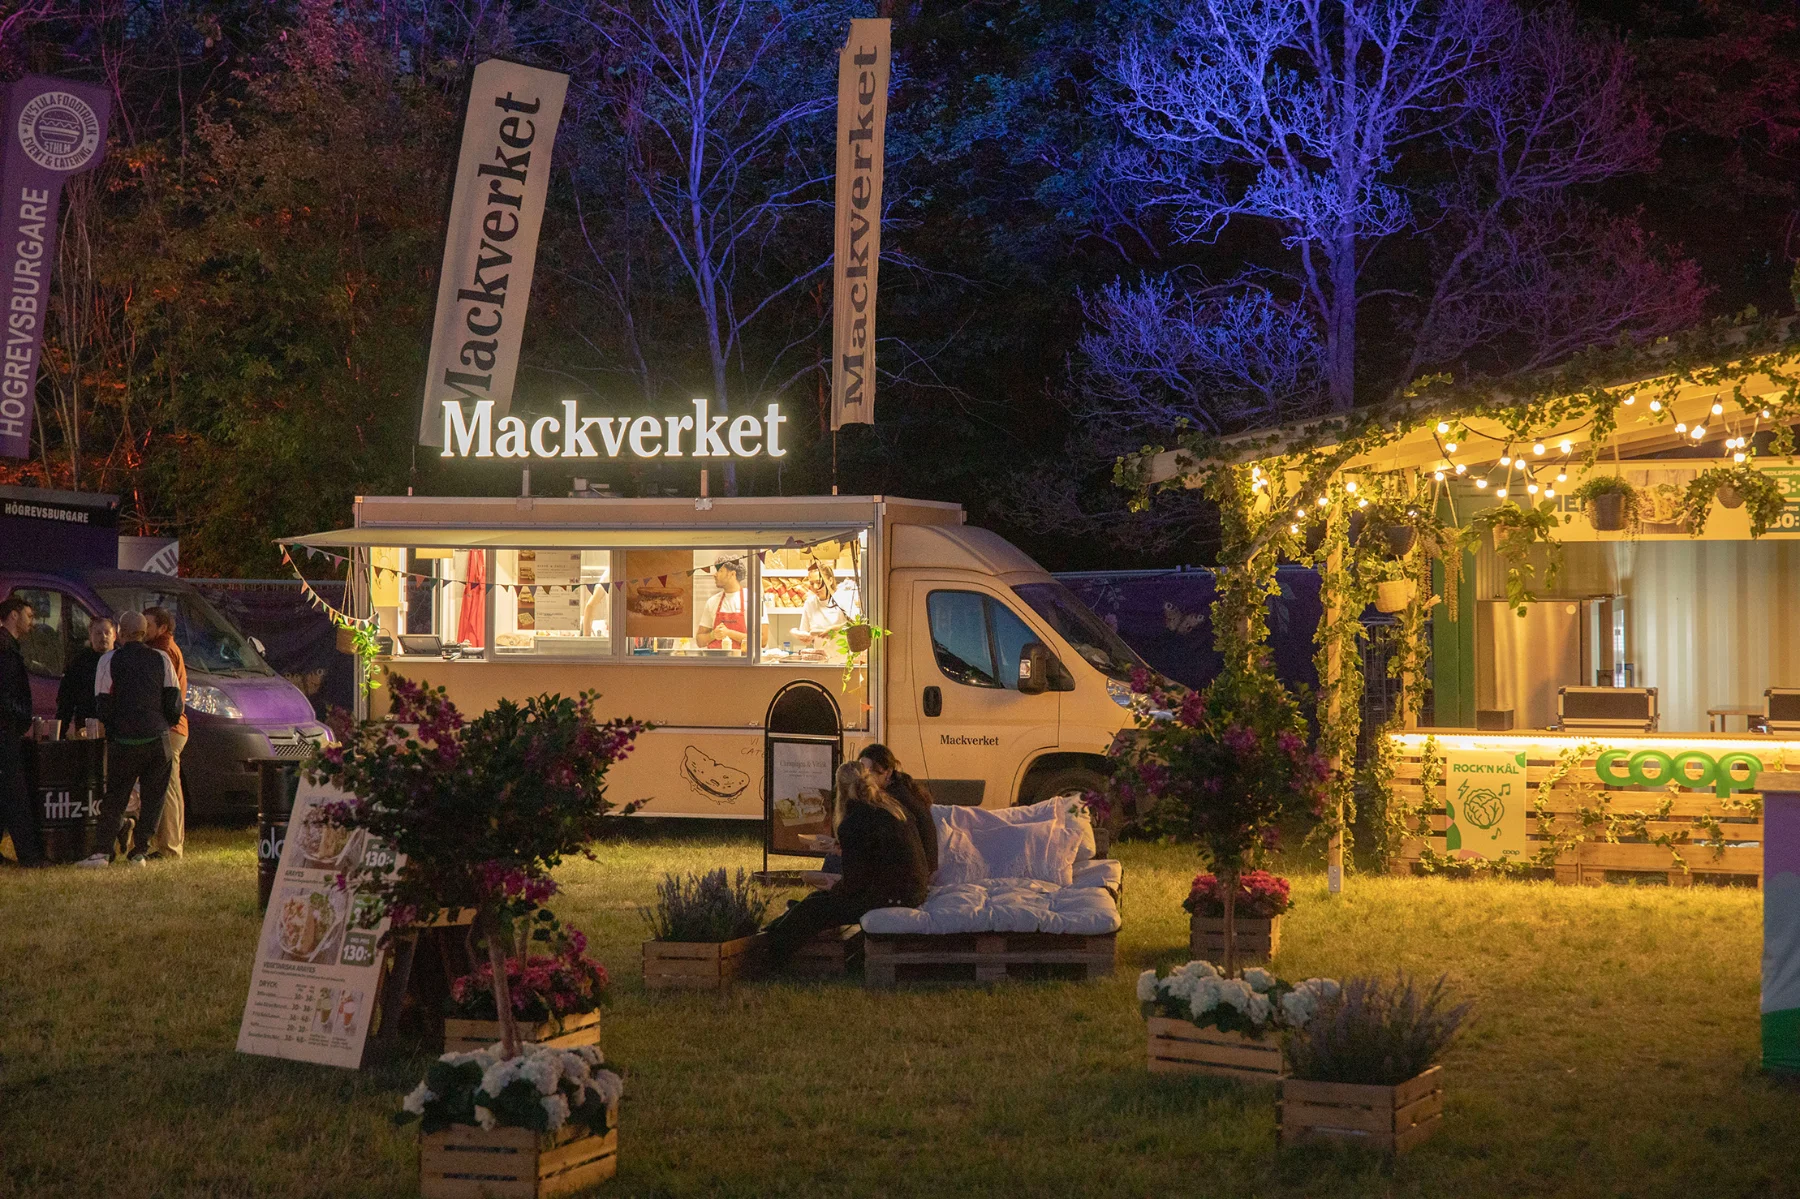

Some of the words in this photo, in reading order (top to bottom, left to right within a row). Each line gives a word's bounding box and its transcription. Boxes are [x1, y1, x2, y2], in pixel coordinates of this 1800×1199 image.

[57, 94, 98, 136] FOODTRUCK
[23, 136, 46, 162] EVENT
[45, 155, 52, 166] &
[54, 147, 92, 168] CATERING
[43, 141, 71, 153] STHLM
[842, 44, 878, 408] Mackverket
[440, 91, 541, 417] Mackverket
[440, 398, 787, 457] Mackverket
[5, 502, 89, 524] HÖGREVSBURGARE
[940, 734, 999, 746] Mackverket
[1453, 763, 1494, 773] ROCK'N
[1496, 762, 1520, 774] KÅL
[1595, 749, 1764, 799] coop
[365, 851, 394, 868] 130:-
[343, 944, 372, 961] 130:-
[258, 980, 278, 989] DRYCK
